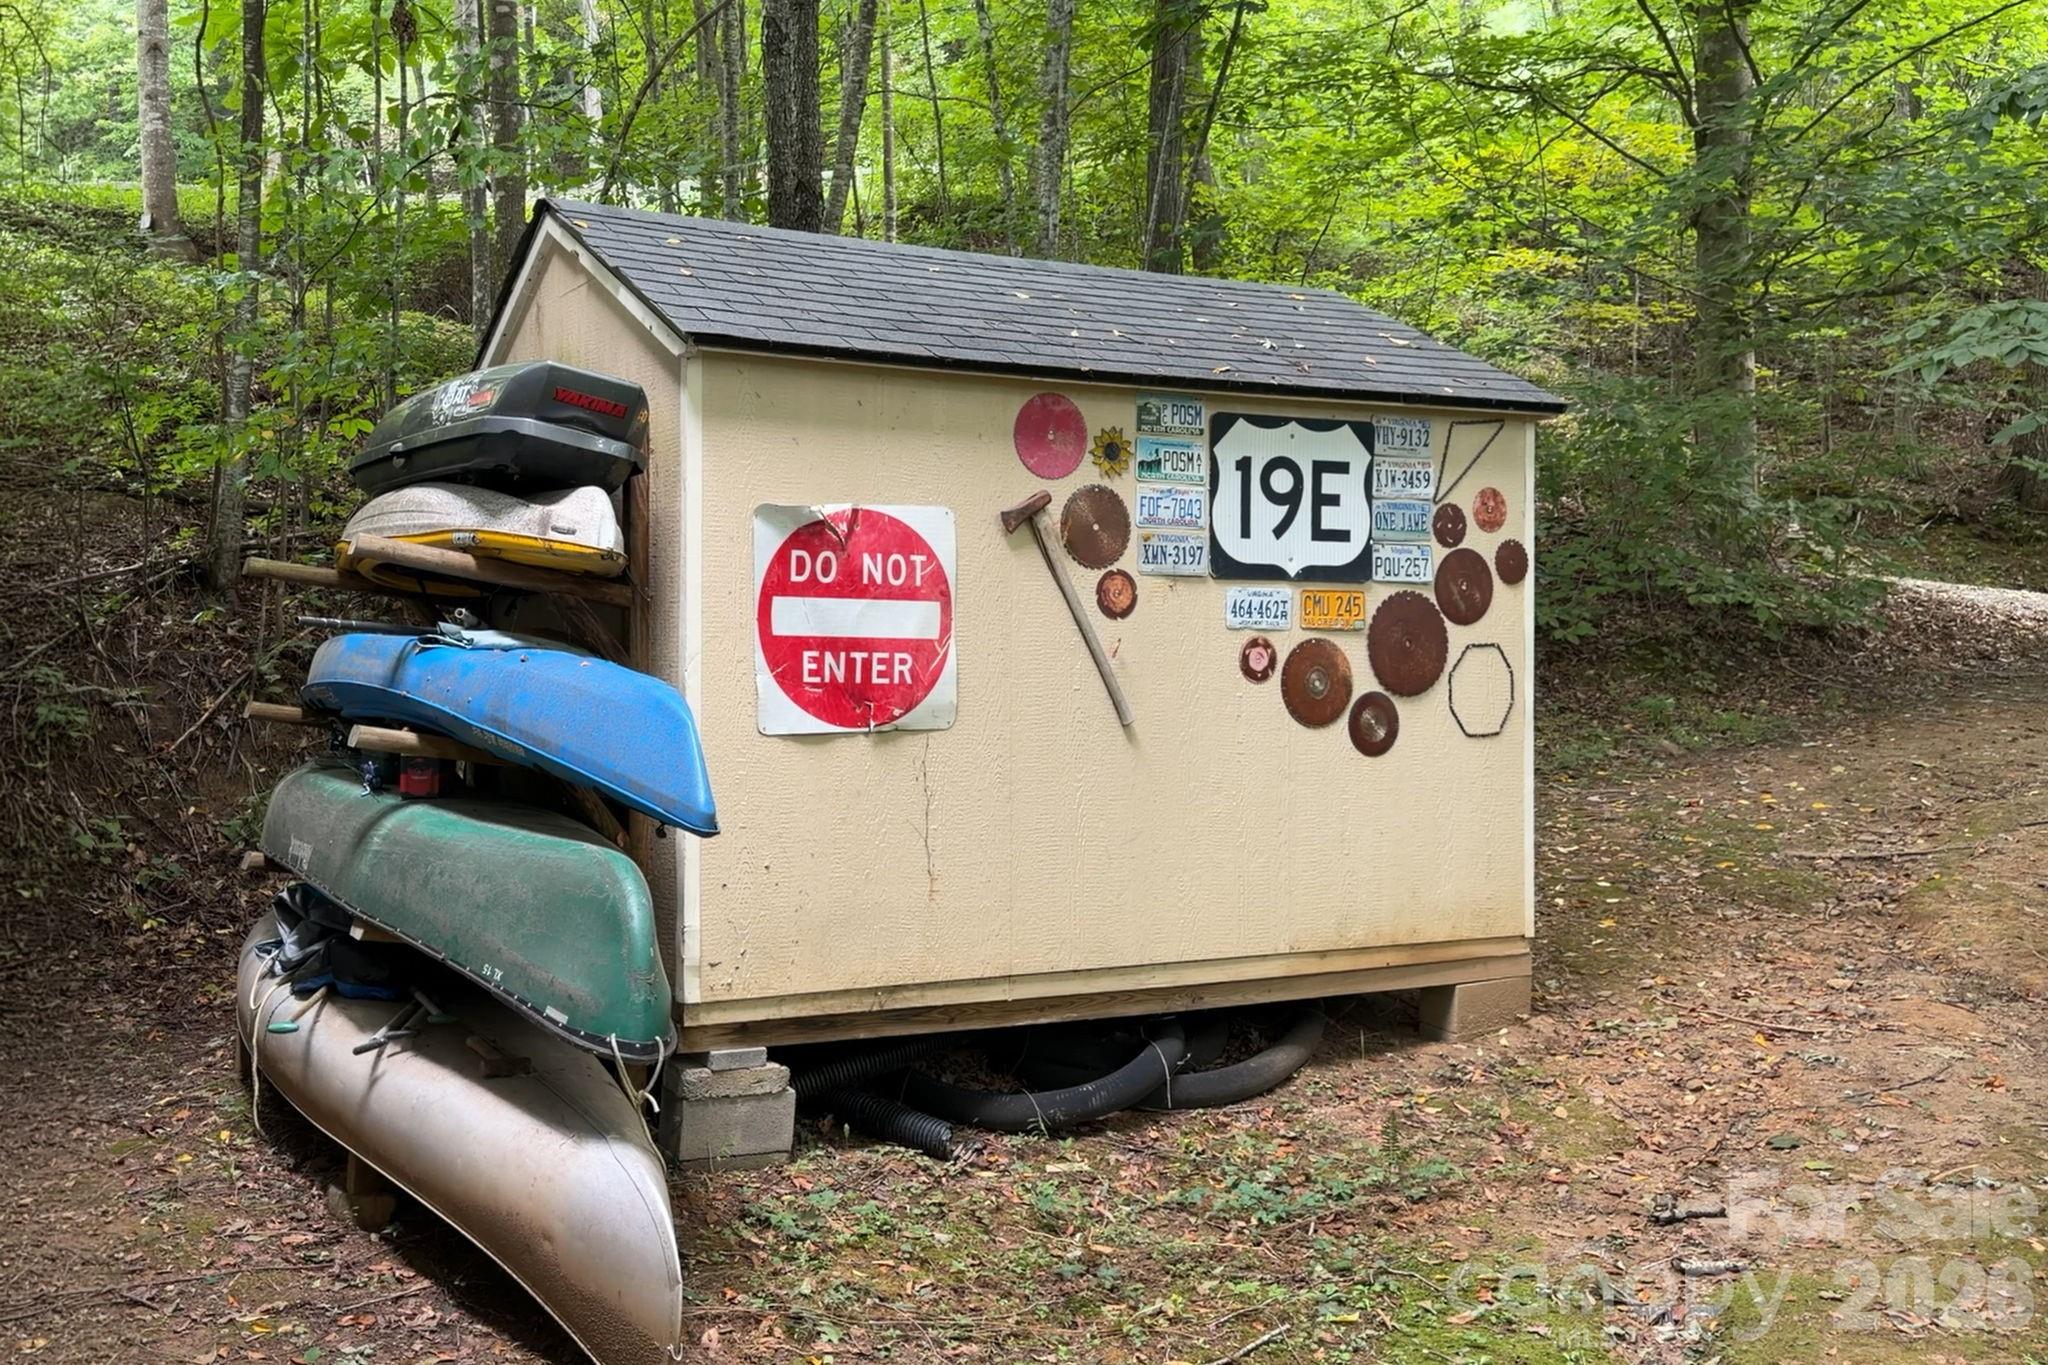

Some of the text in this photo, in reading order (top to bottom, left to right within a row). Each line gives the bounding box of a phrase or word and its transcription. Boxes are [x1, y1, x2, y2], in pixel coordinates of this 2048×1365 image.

[553, 386, 629, 420] YAKIMA
[1171, 404, 1202, 427] POSM
[1163, 450, 1195, 472] POSM
[1235, 455, 1351, 543] 19E
[1375, 511, 1396, 531] ONE
[790, 549, 928, 587] DO NOT
[1304, 595, 1361, 617] CMU 245
[802, 650, 913, 685] ENTER
